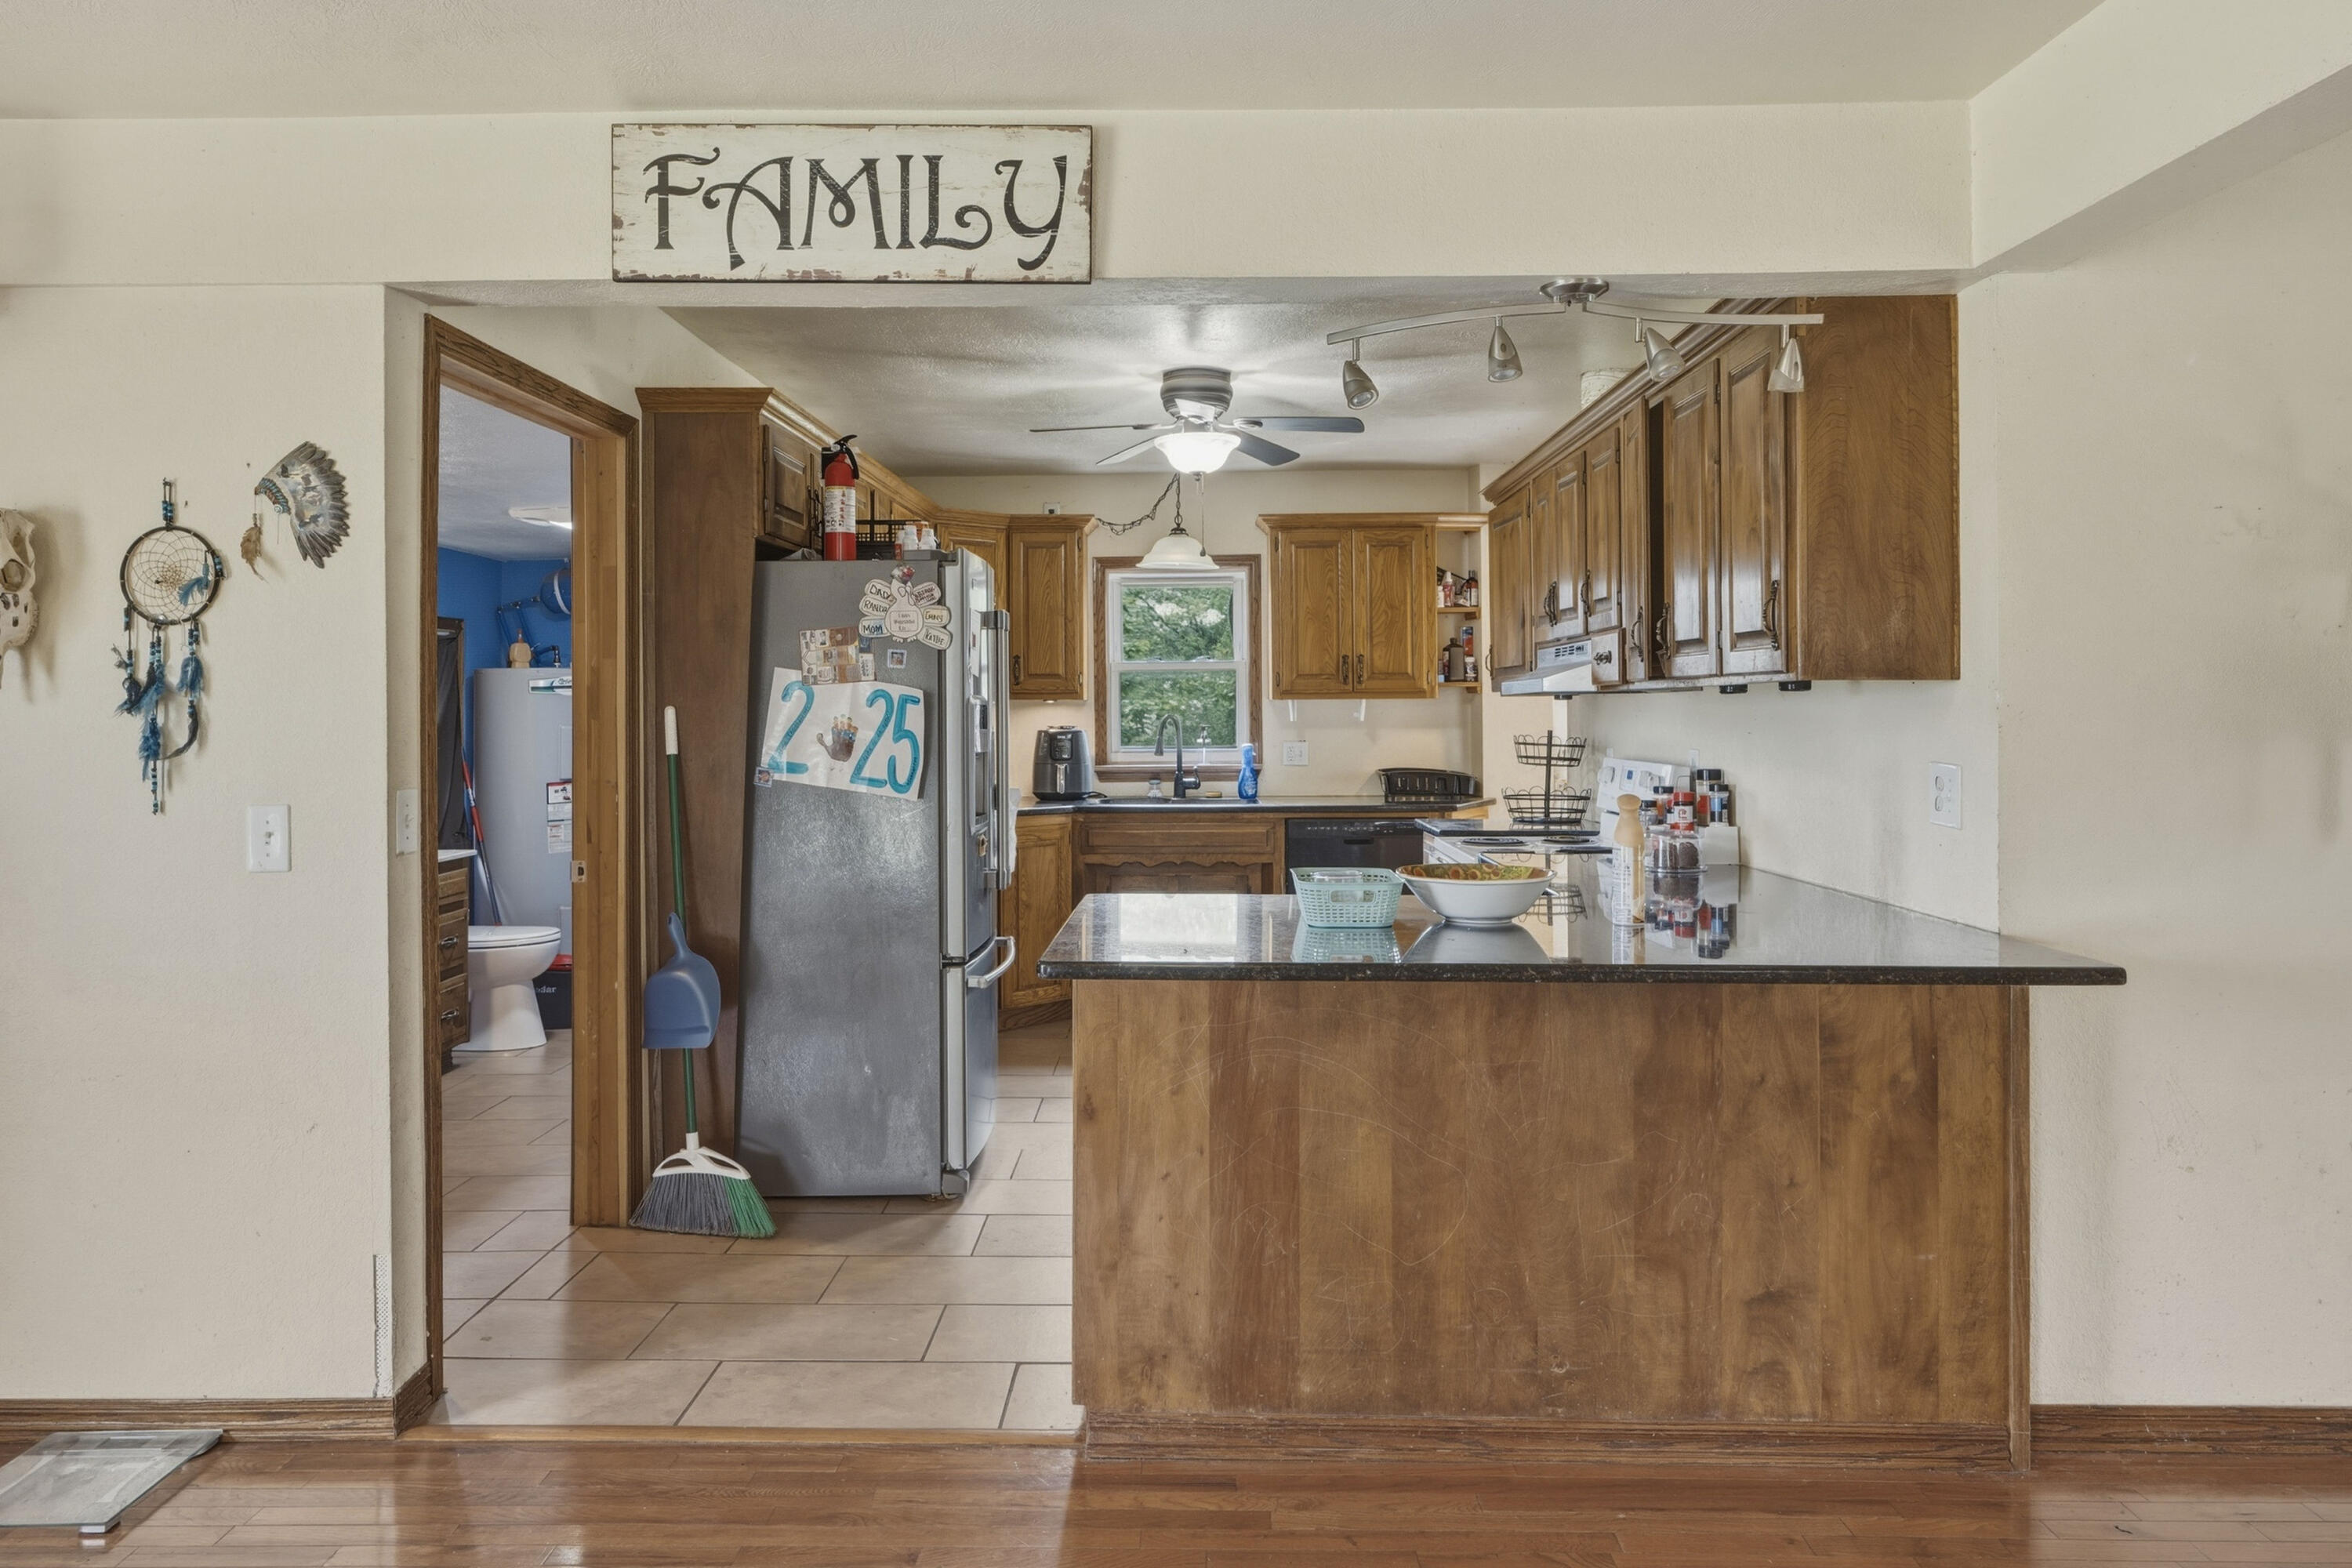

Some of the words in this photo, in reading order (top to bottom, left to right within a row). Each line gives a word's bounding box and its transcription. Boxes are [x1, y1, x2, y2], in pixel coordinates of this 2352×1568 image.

[643, 147, 1068, 270] FAMILY
[863, 625, 884, 635] MOM
[850, 689, 920, 794] 25
